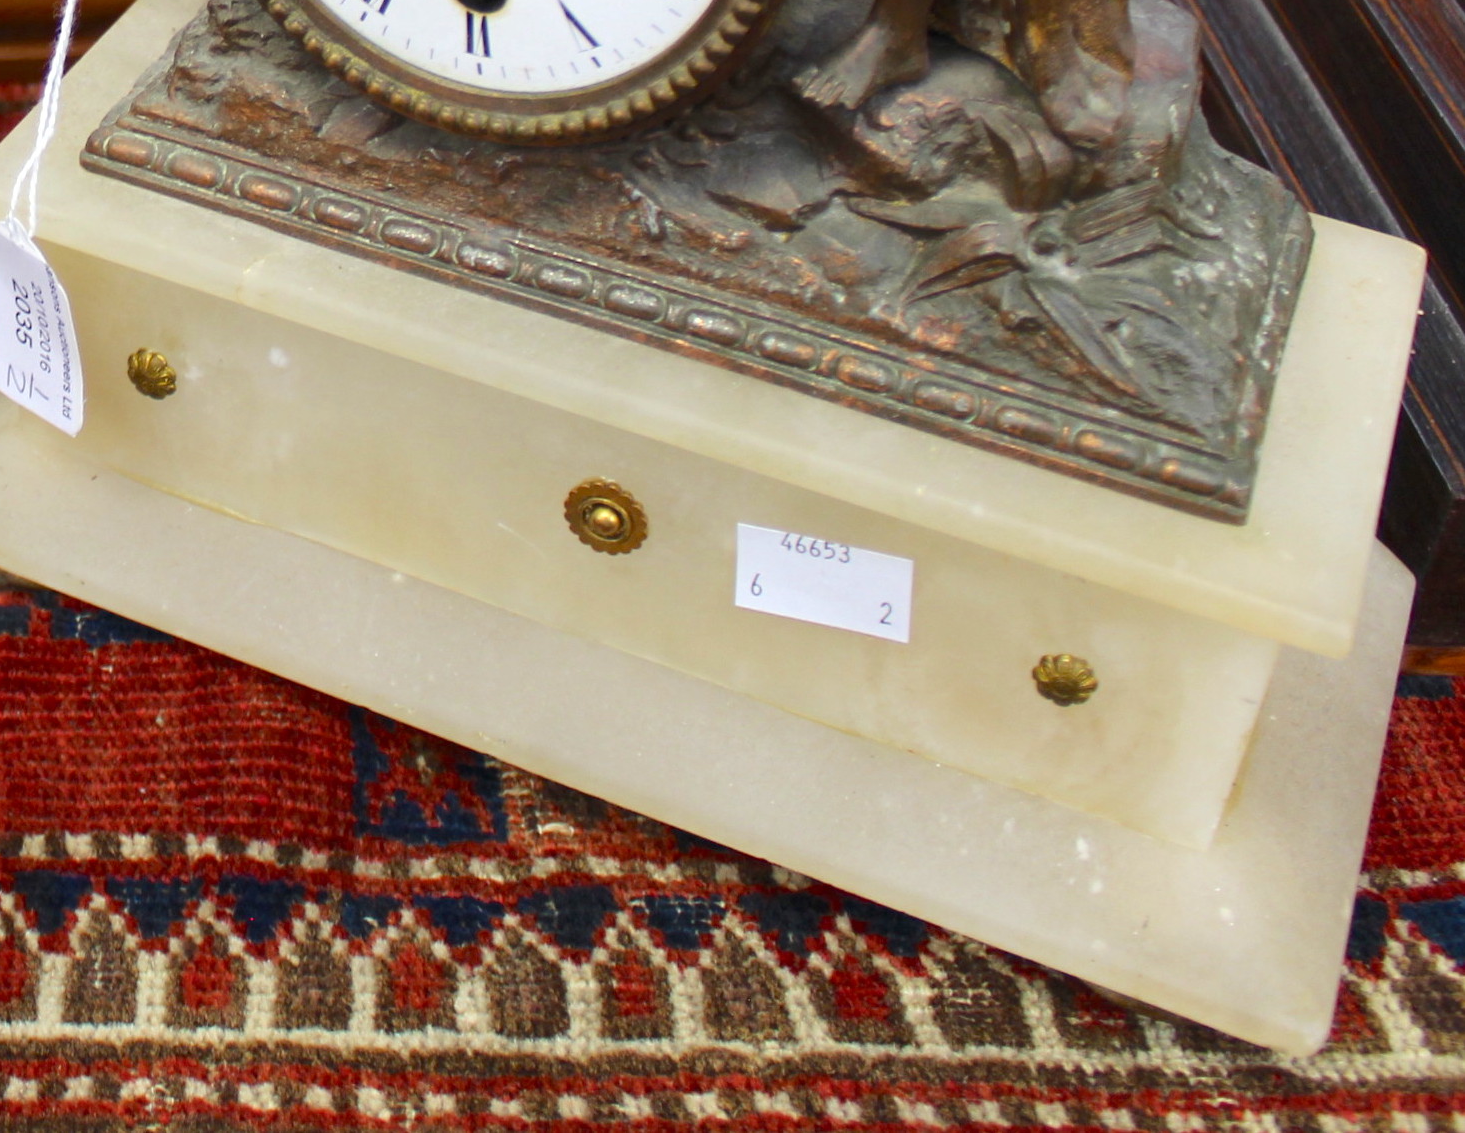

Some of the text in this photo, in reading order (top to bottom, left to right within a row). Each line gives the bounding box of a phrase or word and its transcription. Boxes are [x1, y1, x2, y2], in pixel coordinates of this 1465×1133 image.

[11, 278, 33, 349] 2035
[30, 281, 51, 375] 20/10/2016
[62, 395, 73, 419] Ltd
[780, 532, 851, 564] 46653
[750, 573, 763, 597] 6
[879, 602, 892, 626] 2
